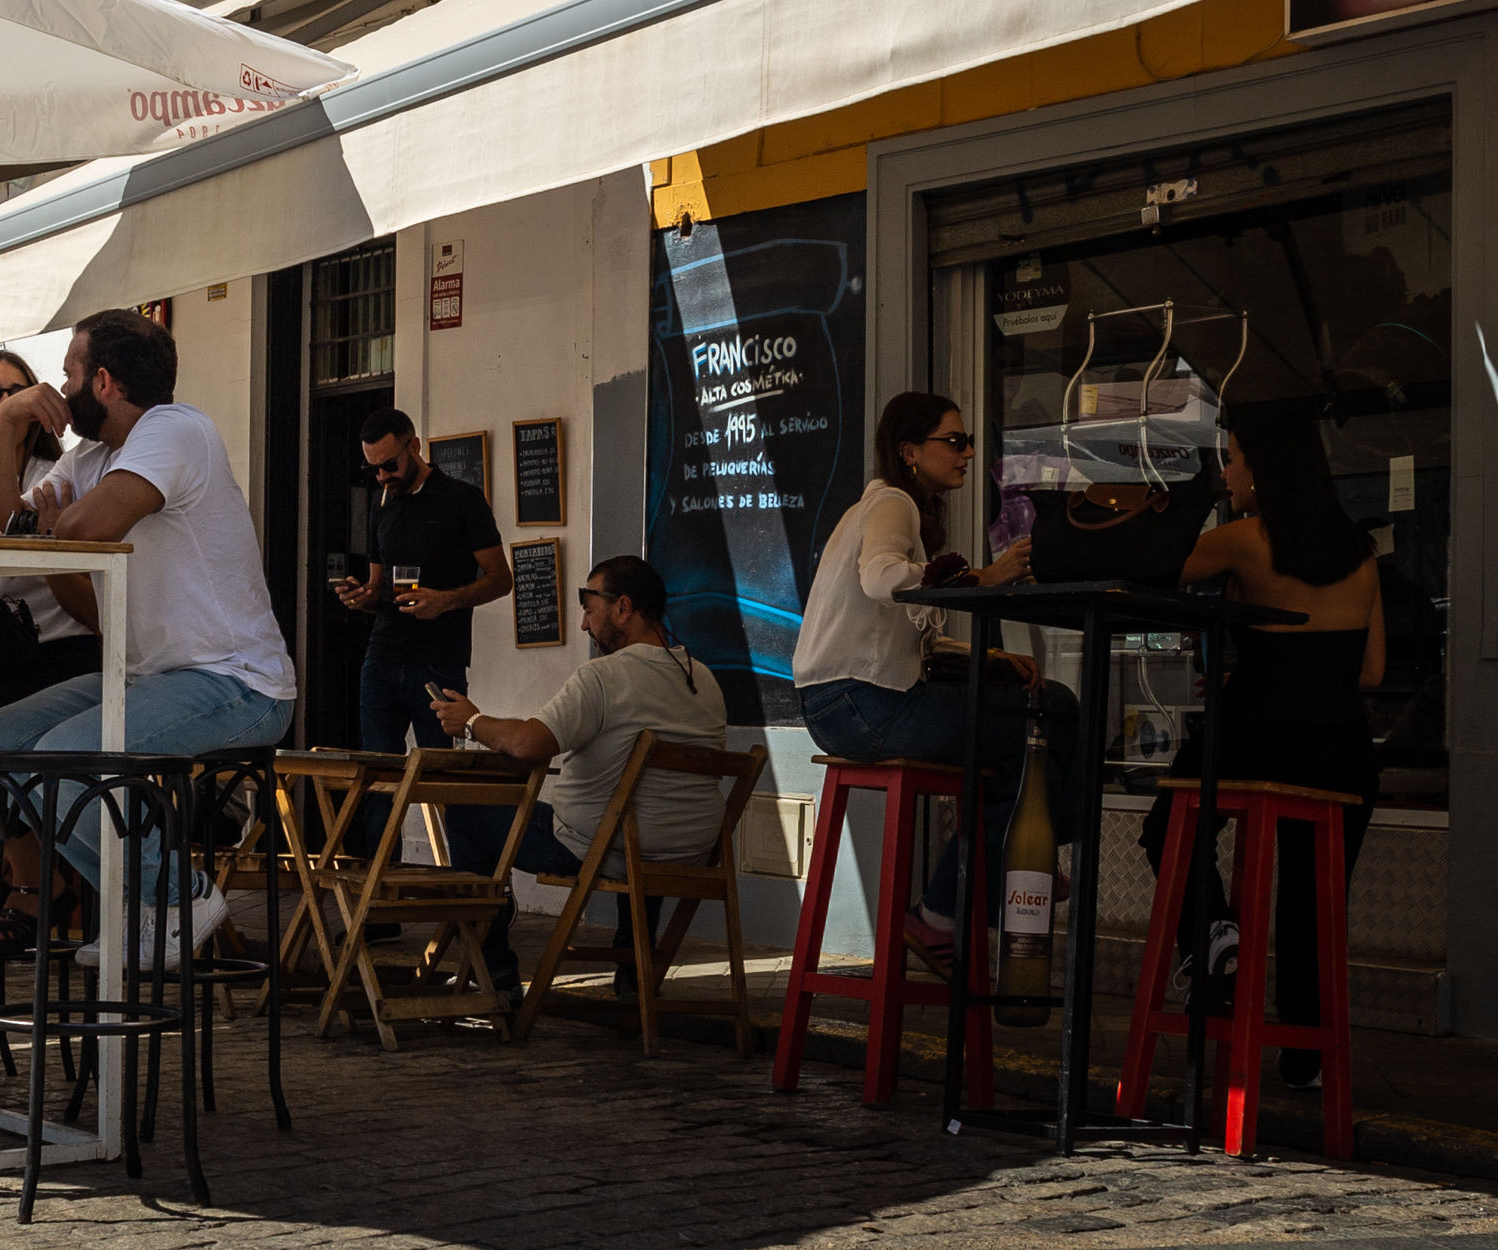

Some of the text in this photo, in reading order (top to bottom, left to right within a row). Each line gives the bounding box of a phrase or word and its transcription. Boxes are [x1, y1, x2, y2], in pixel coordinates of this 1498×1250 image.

[433, 279, 460, 292] Alarma
[692, 334, 797, 380] FRANCISCO
[701, 365, 798, 406] ALTA COSMÉTICA
[519, 426, 550, 442] TAPAS
[685, 412, 828, 450] DESDE 1995 AL SERVICIO
[684, 452, 776, 480] DE PELUQUERÍAS
[682, 493, 733, 512] SALONES
[739, 494, 752, 508] DE
[758, 492, 805, 509] BELLEZA
[1008, 889, 1048, 906] Solear
